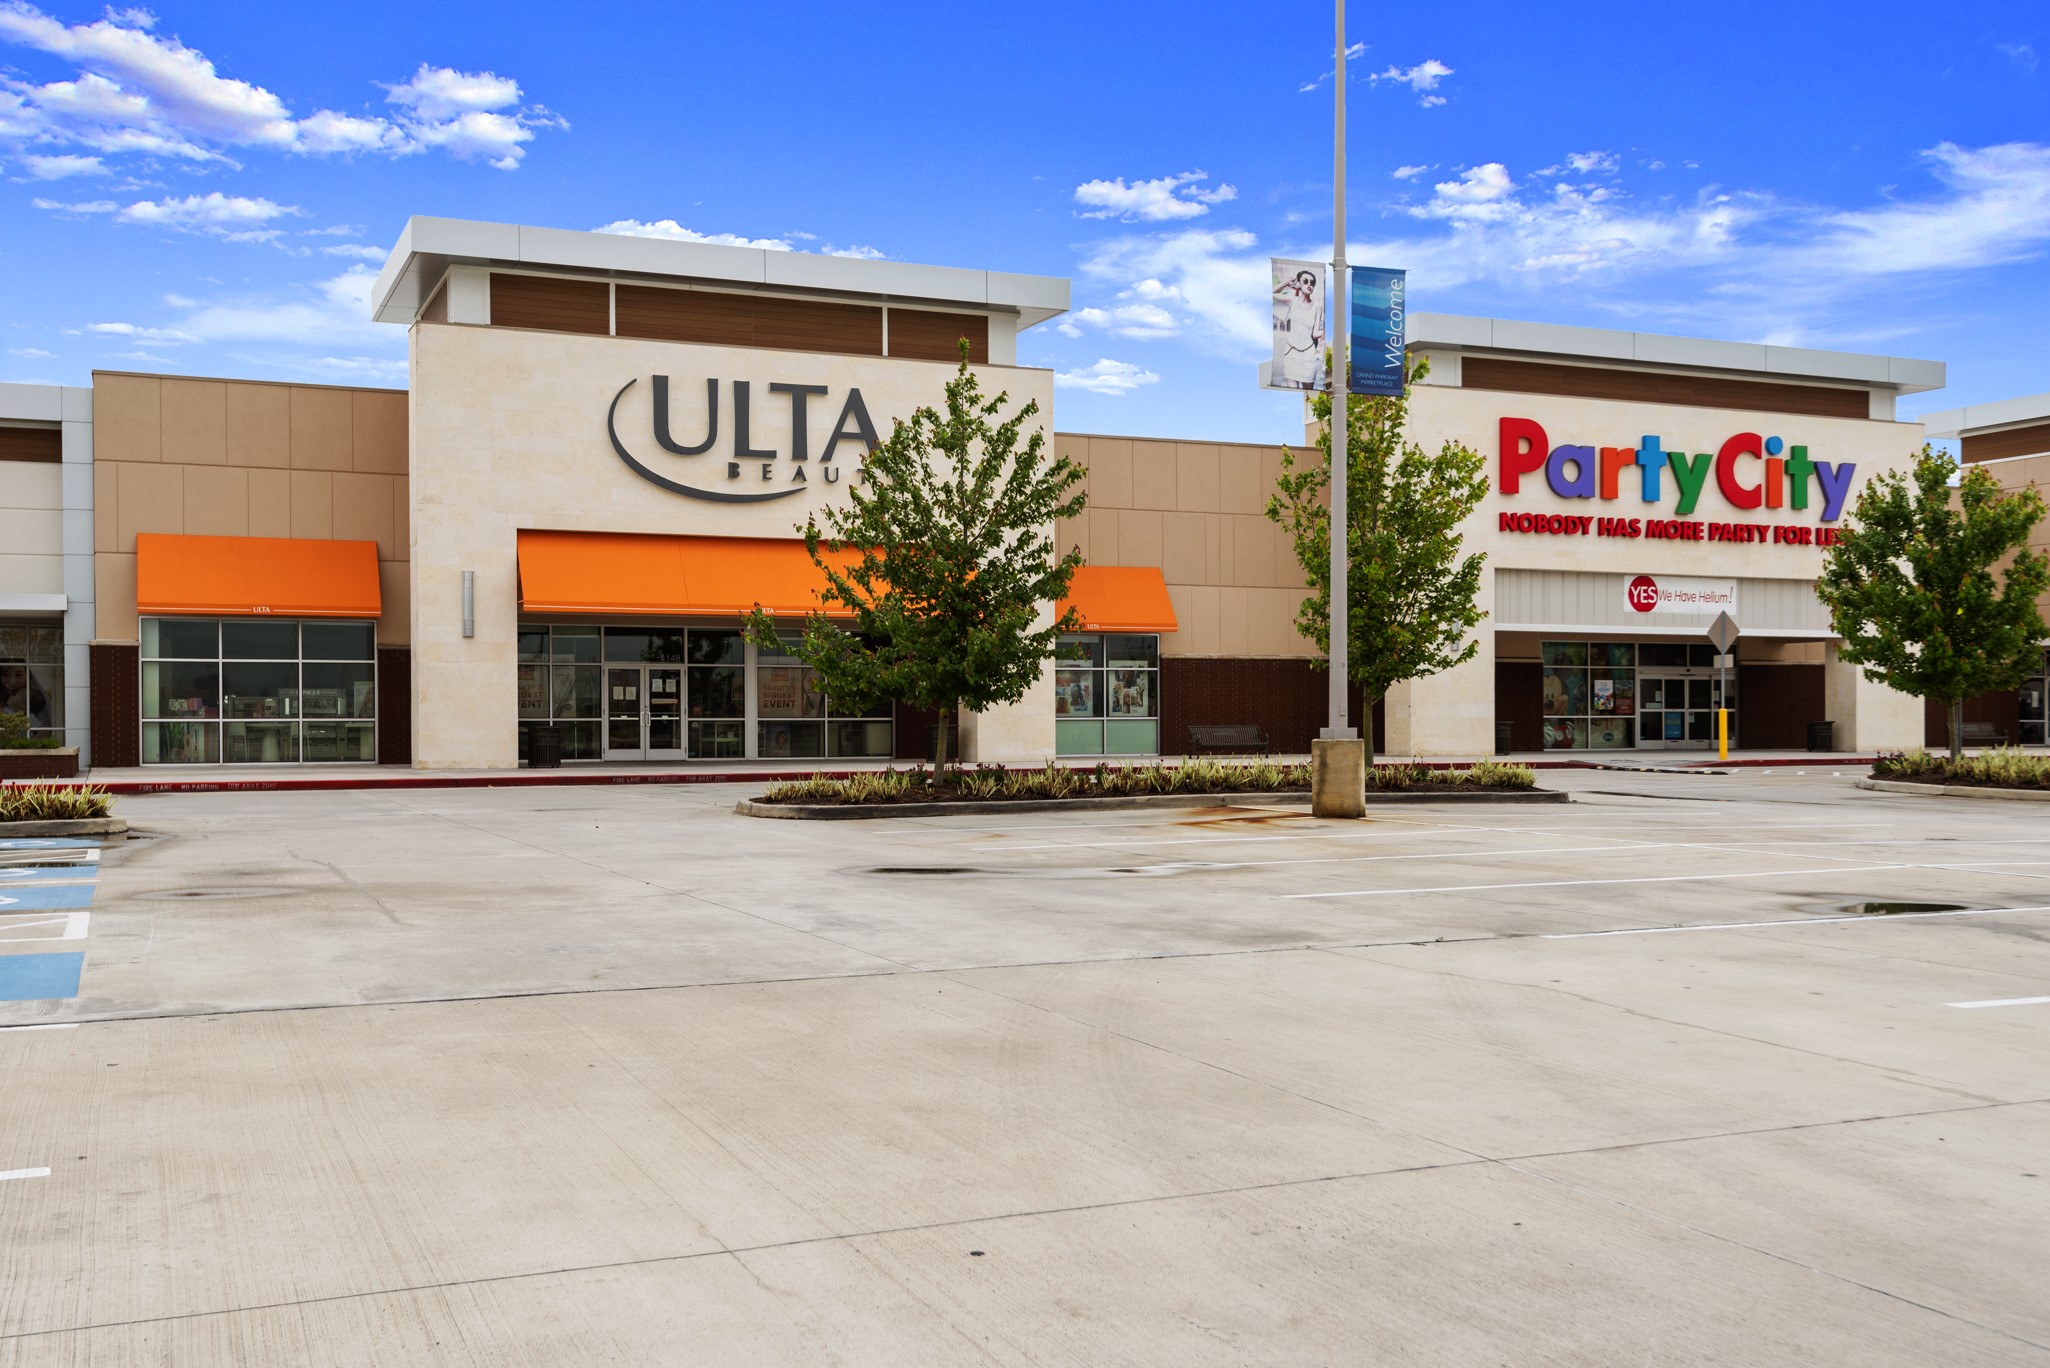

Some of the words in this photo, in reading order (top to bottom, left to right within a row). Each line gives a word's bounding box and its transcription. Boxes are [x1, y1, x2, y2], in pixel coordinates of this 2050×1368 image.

[1384, 279, 1403, 368] Welcome
[1360, 379, 1393, 387] MARKETPLACE
[651, 374, 886, 462] ULTA
[727, 461, 868, 486] BEAUT
[1499, 416, 1713, 514] Party
[1715, 431, 1856, 521] City
[1499, 512, 1594, 536] NOBODY
[1598, 517, 1641, 538] HAS
[1645, 519, 1704, 541] MORE
[1708, 522, 1770, 544] PARTY
[1774, 525, 1813, 546] FOR
[1630, 586, 1657, 604] YES
[1659, 589, 1672, 602] We
[1674, 590, 1697, 603] Have
[1698, 586, 1734, 604] Helium!
[763, 684, 797, 692] BEAUTY'S
[763, 699, 797, 709] EVENT
[138, 784, 153, 792] FIRE
[155, 783, 173, 791] LANE
[227, 782, 240, 790] TOW
